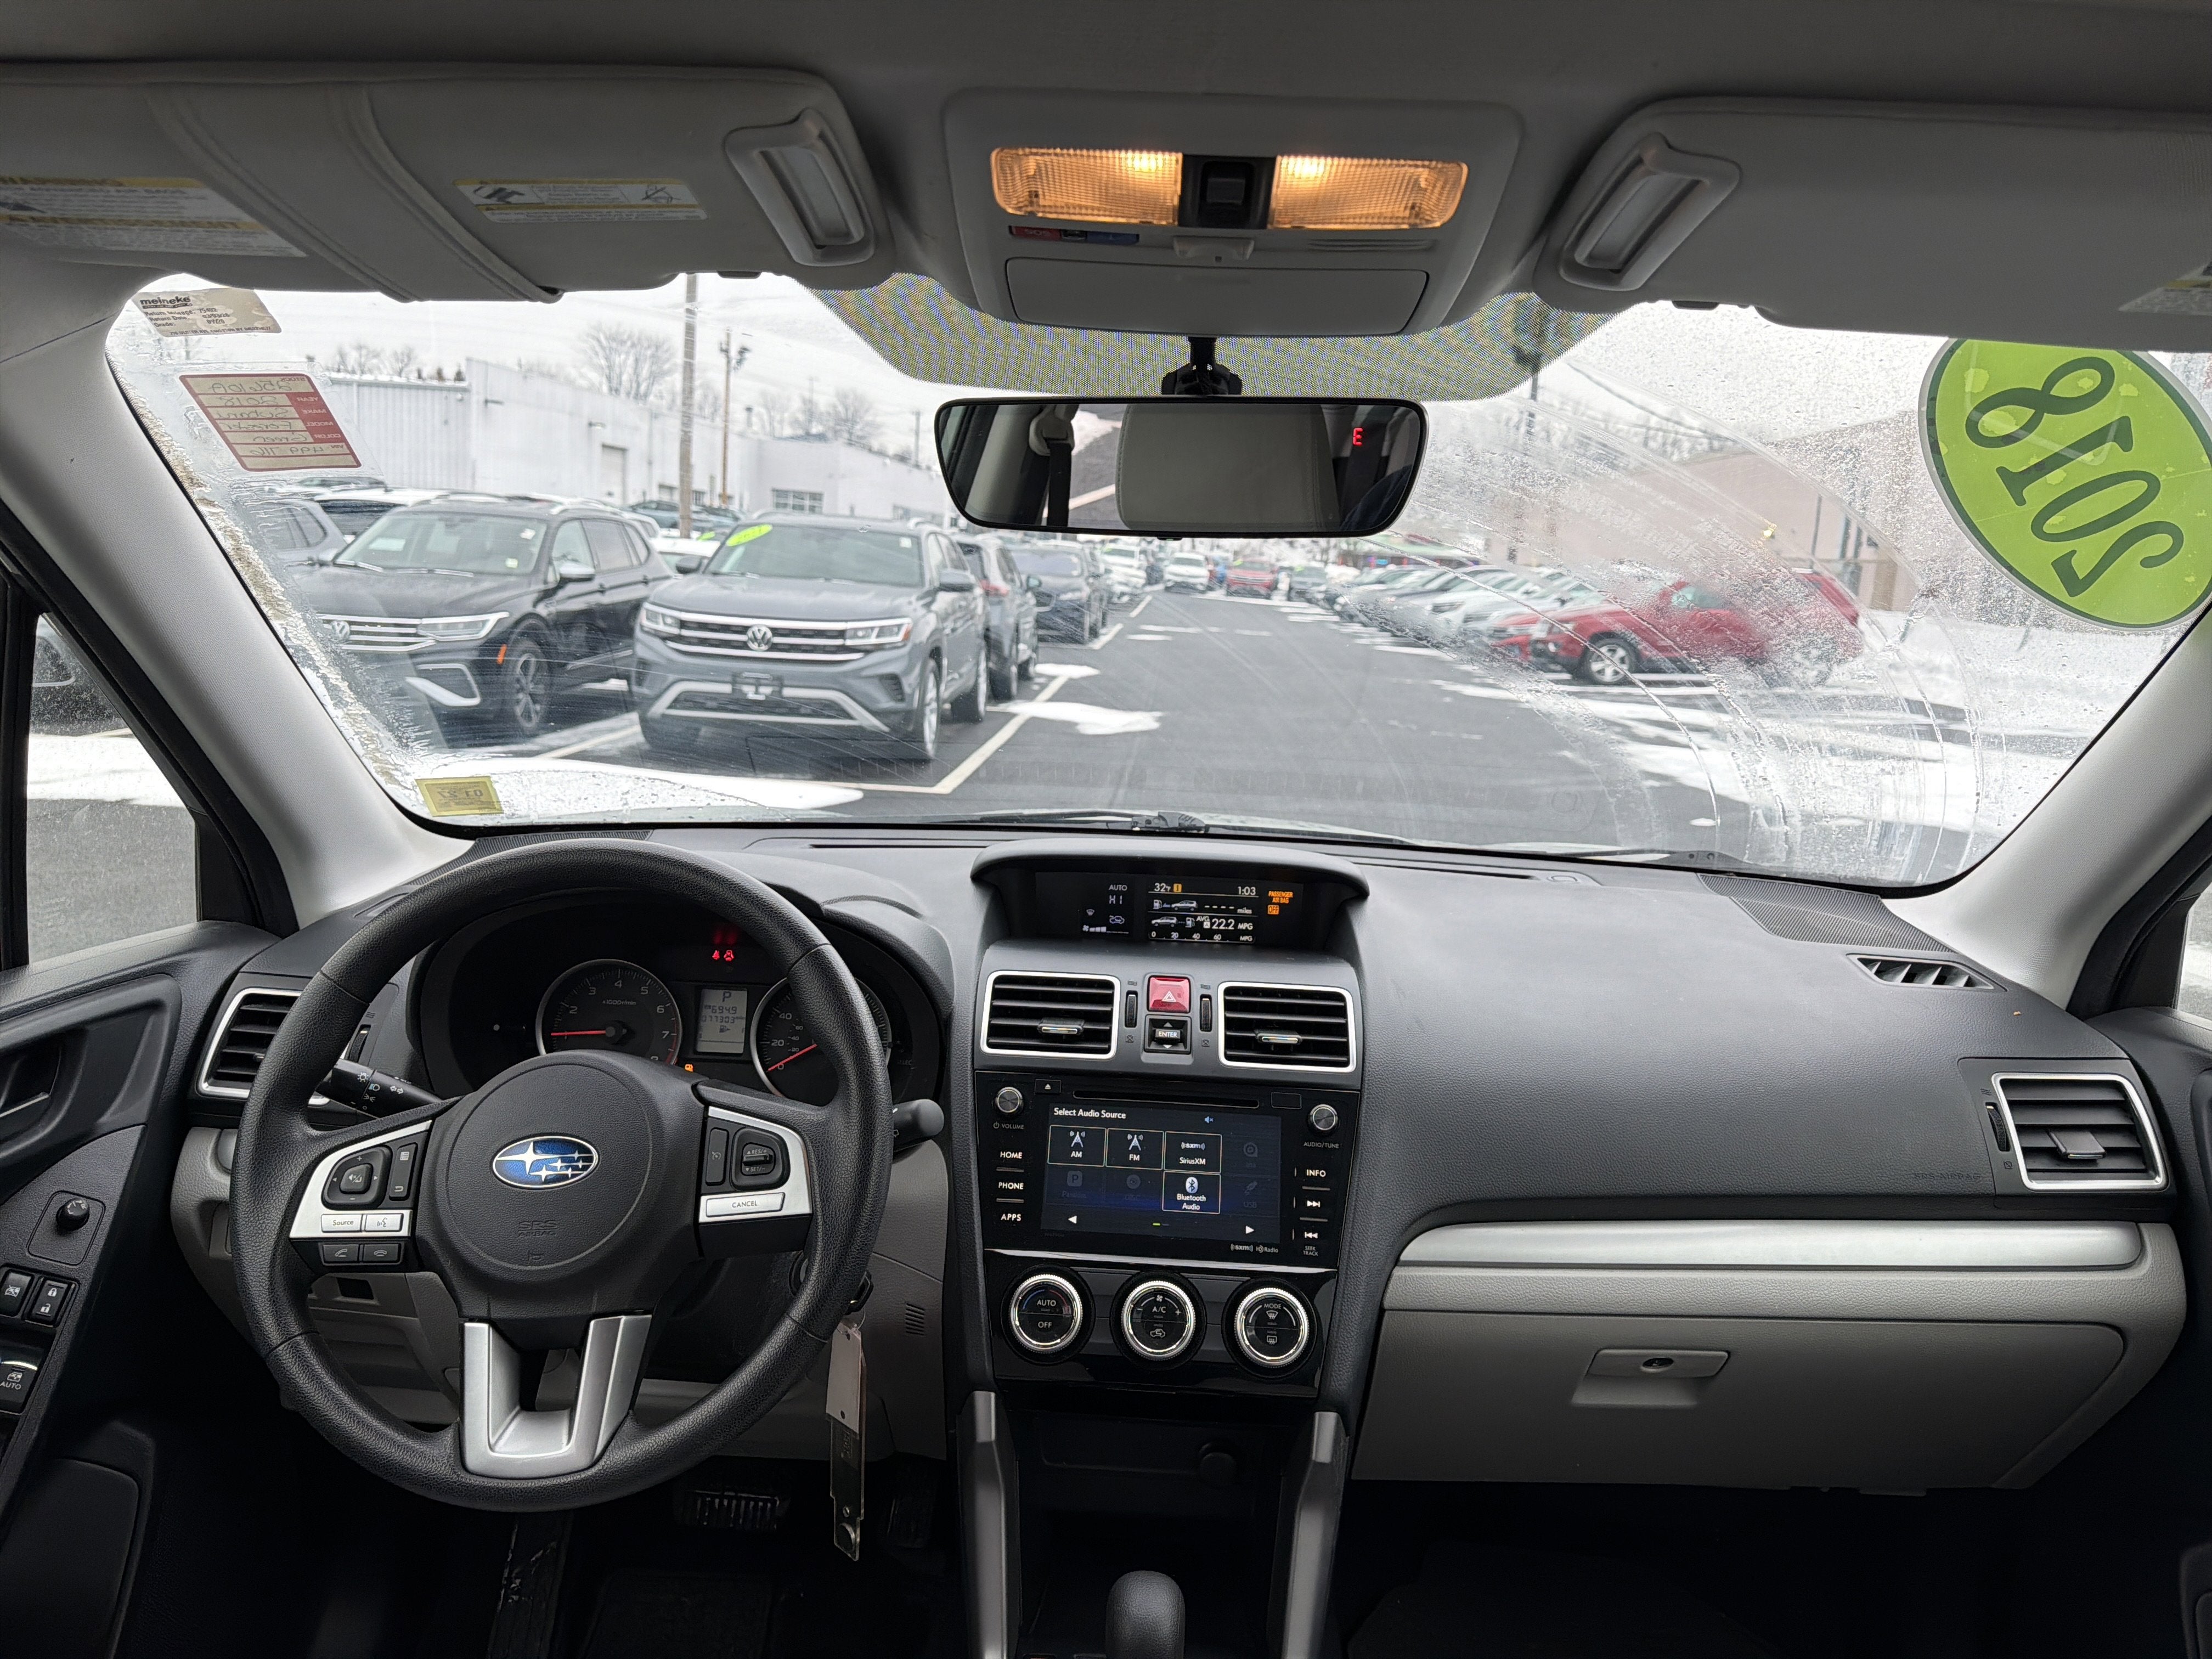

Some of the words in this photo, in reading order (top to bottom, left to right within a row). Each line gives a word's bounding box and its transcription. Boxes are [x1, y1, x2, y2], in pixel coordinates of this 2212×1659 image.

[139, 296, 190, 304] meineke
[1352, 427, 1363, 446] E
[1238, 886, 1256, 895] 1:03
[1109, 895, 1122, 904] HI
[1211, 918, 1234, 930] 22.2
[588, 987, 596, 995] 3
[640, 986, 648, 995] 5
[722, 991, 732, 1002] P
[569, 1006, 578, 1014] 2
[657, 1005, 665, 1014] 6
[702, 1015, 735, 1024] 077303
[662, 1030, 670, 1039] 7
[1054, 1107, 1076, 1116] Select
[1077, 1109, 1100, 1118] Audio
[1101, 1111, 1126, 1119] Source
[1180, 1157, 1206, 1165] SiriusXM
[1306, 1169, 1326, 1177] INFO
[1177, 1194, 1206, 1202] Bluetooth
[1037, 1299, 1057, 1307] AUTO
[1152, 1305, 1166, 1313] A/C
[0, 1381, 21, 1390] AUTO
